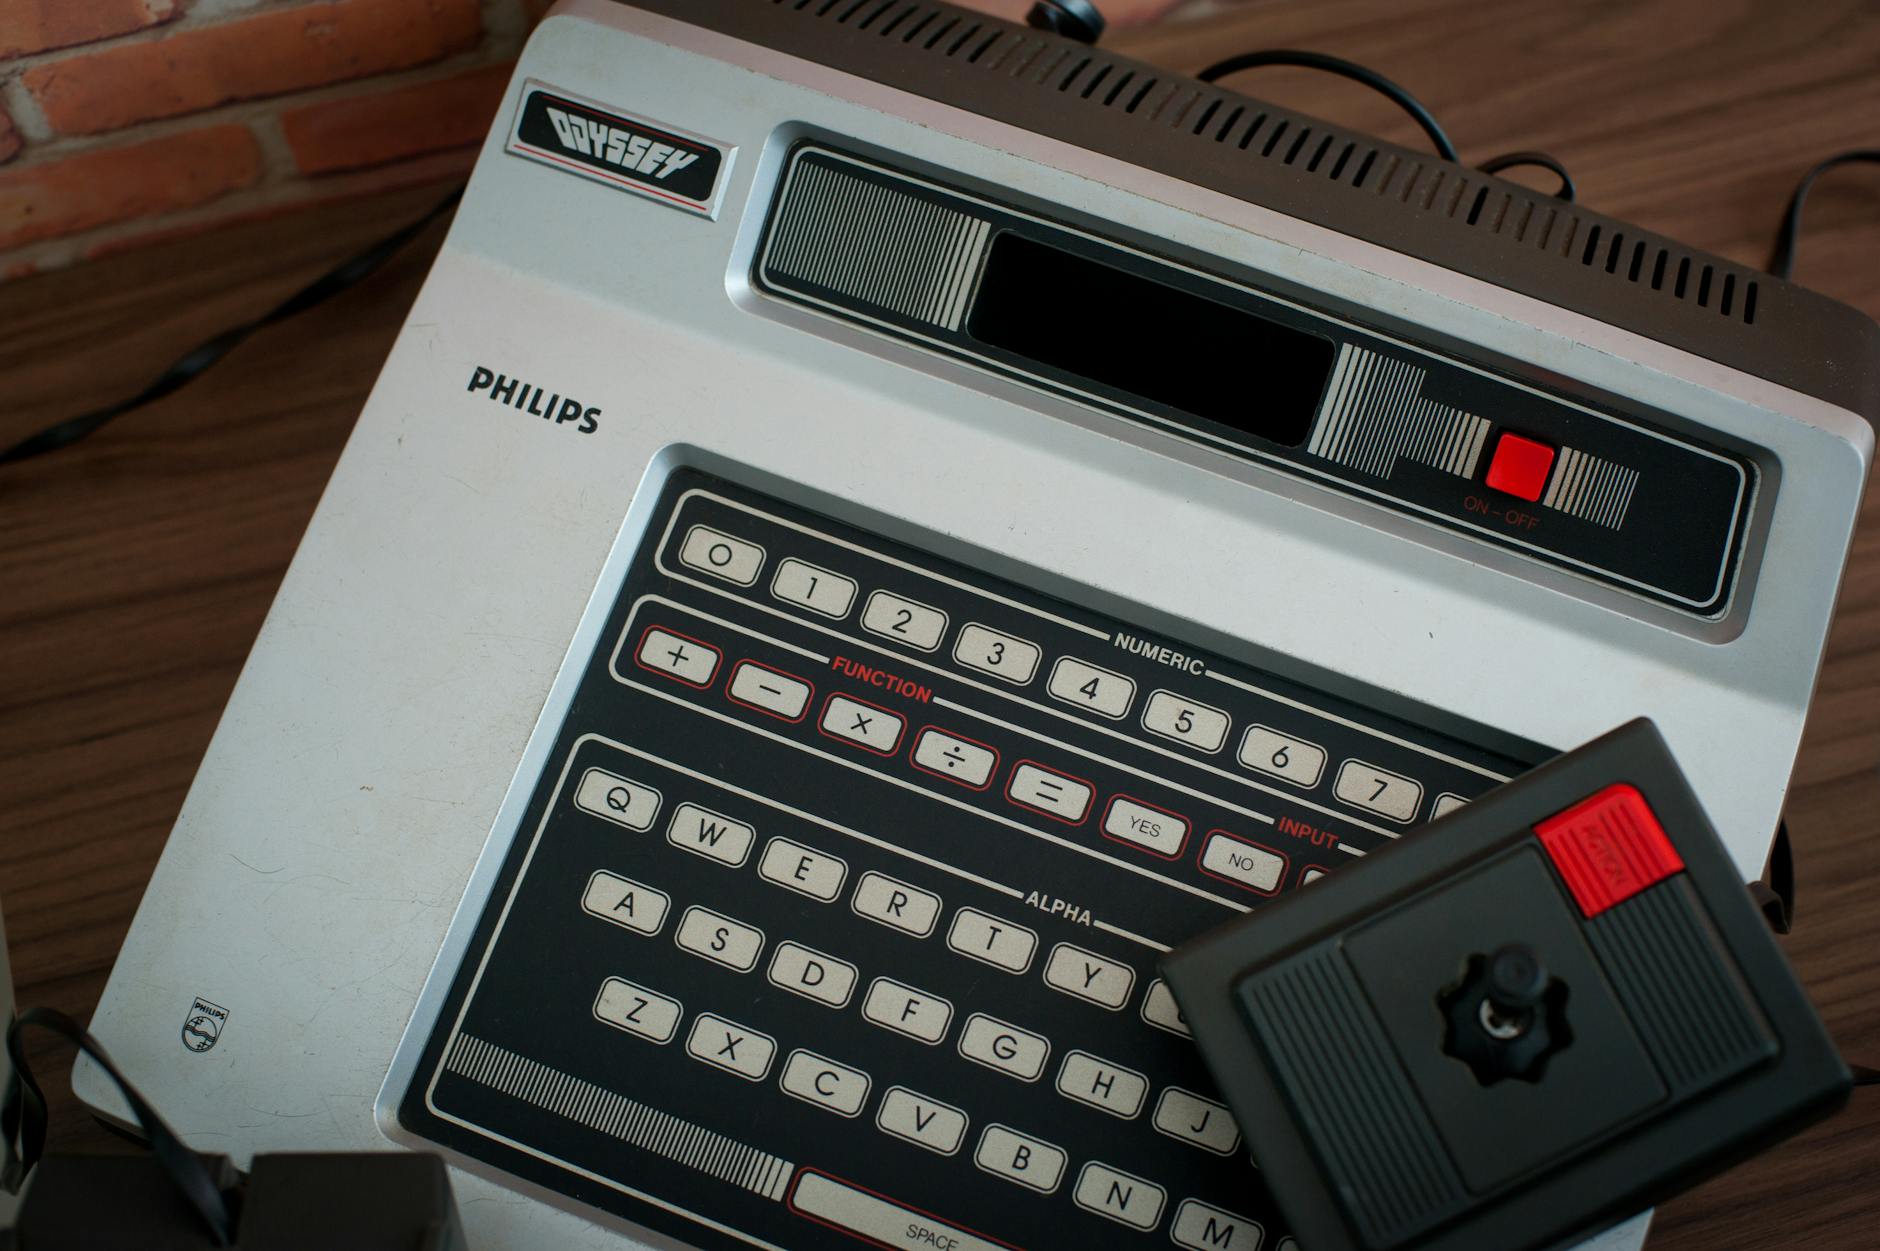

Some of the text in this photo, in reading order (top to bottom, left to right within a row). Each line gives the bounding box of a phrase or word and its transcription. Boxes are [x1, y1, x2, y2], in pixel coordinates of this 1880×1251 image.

[546, 107, 699, 179] ODYSSEY
[467, 366, 602, 434] PHILIPS
[1463, 495, 1489, 515] ON
[1505, 509, 1539, 529] OFF
[1114, 632, 1204, 675] NUMERIC
[806, 577, 818, 600] 1
[891, 609, 912, 634] 2
[987, 642, 1005, 666] 3
[1079, 677, 1100, 700] 4
[1174, 709, 1195, 734] 5
[1271, 745, 1289, 769] 6
[1368, 778, 1388, 802] 7
[832, 656, 932, 703] FUNCTION
[1130, 815, 1162, 838] YES
[1278, 816, 1339, 849] INPUT
[1227, 852, 1255, 872] NO
[606, 786, 1102, 988] Q W E R T Y
[1025, 890, 1091, 926] ALPHA
[195, 1002, 226, 1020] PHILIPS
[613, 891, 1211, 1134] A S D F G H J
[625, 997, 1235, 1250] Z X C V B N M
